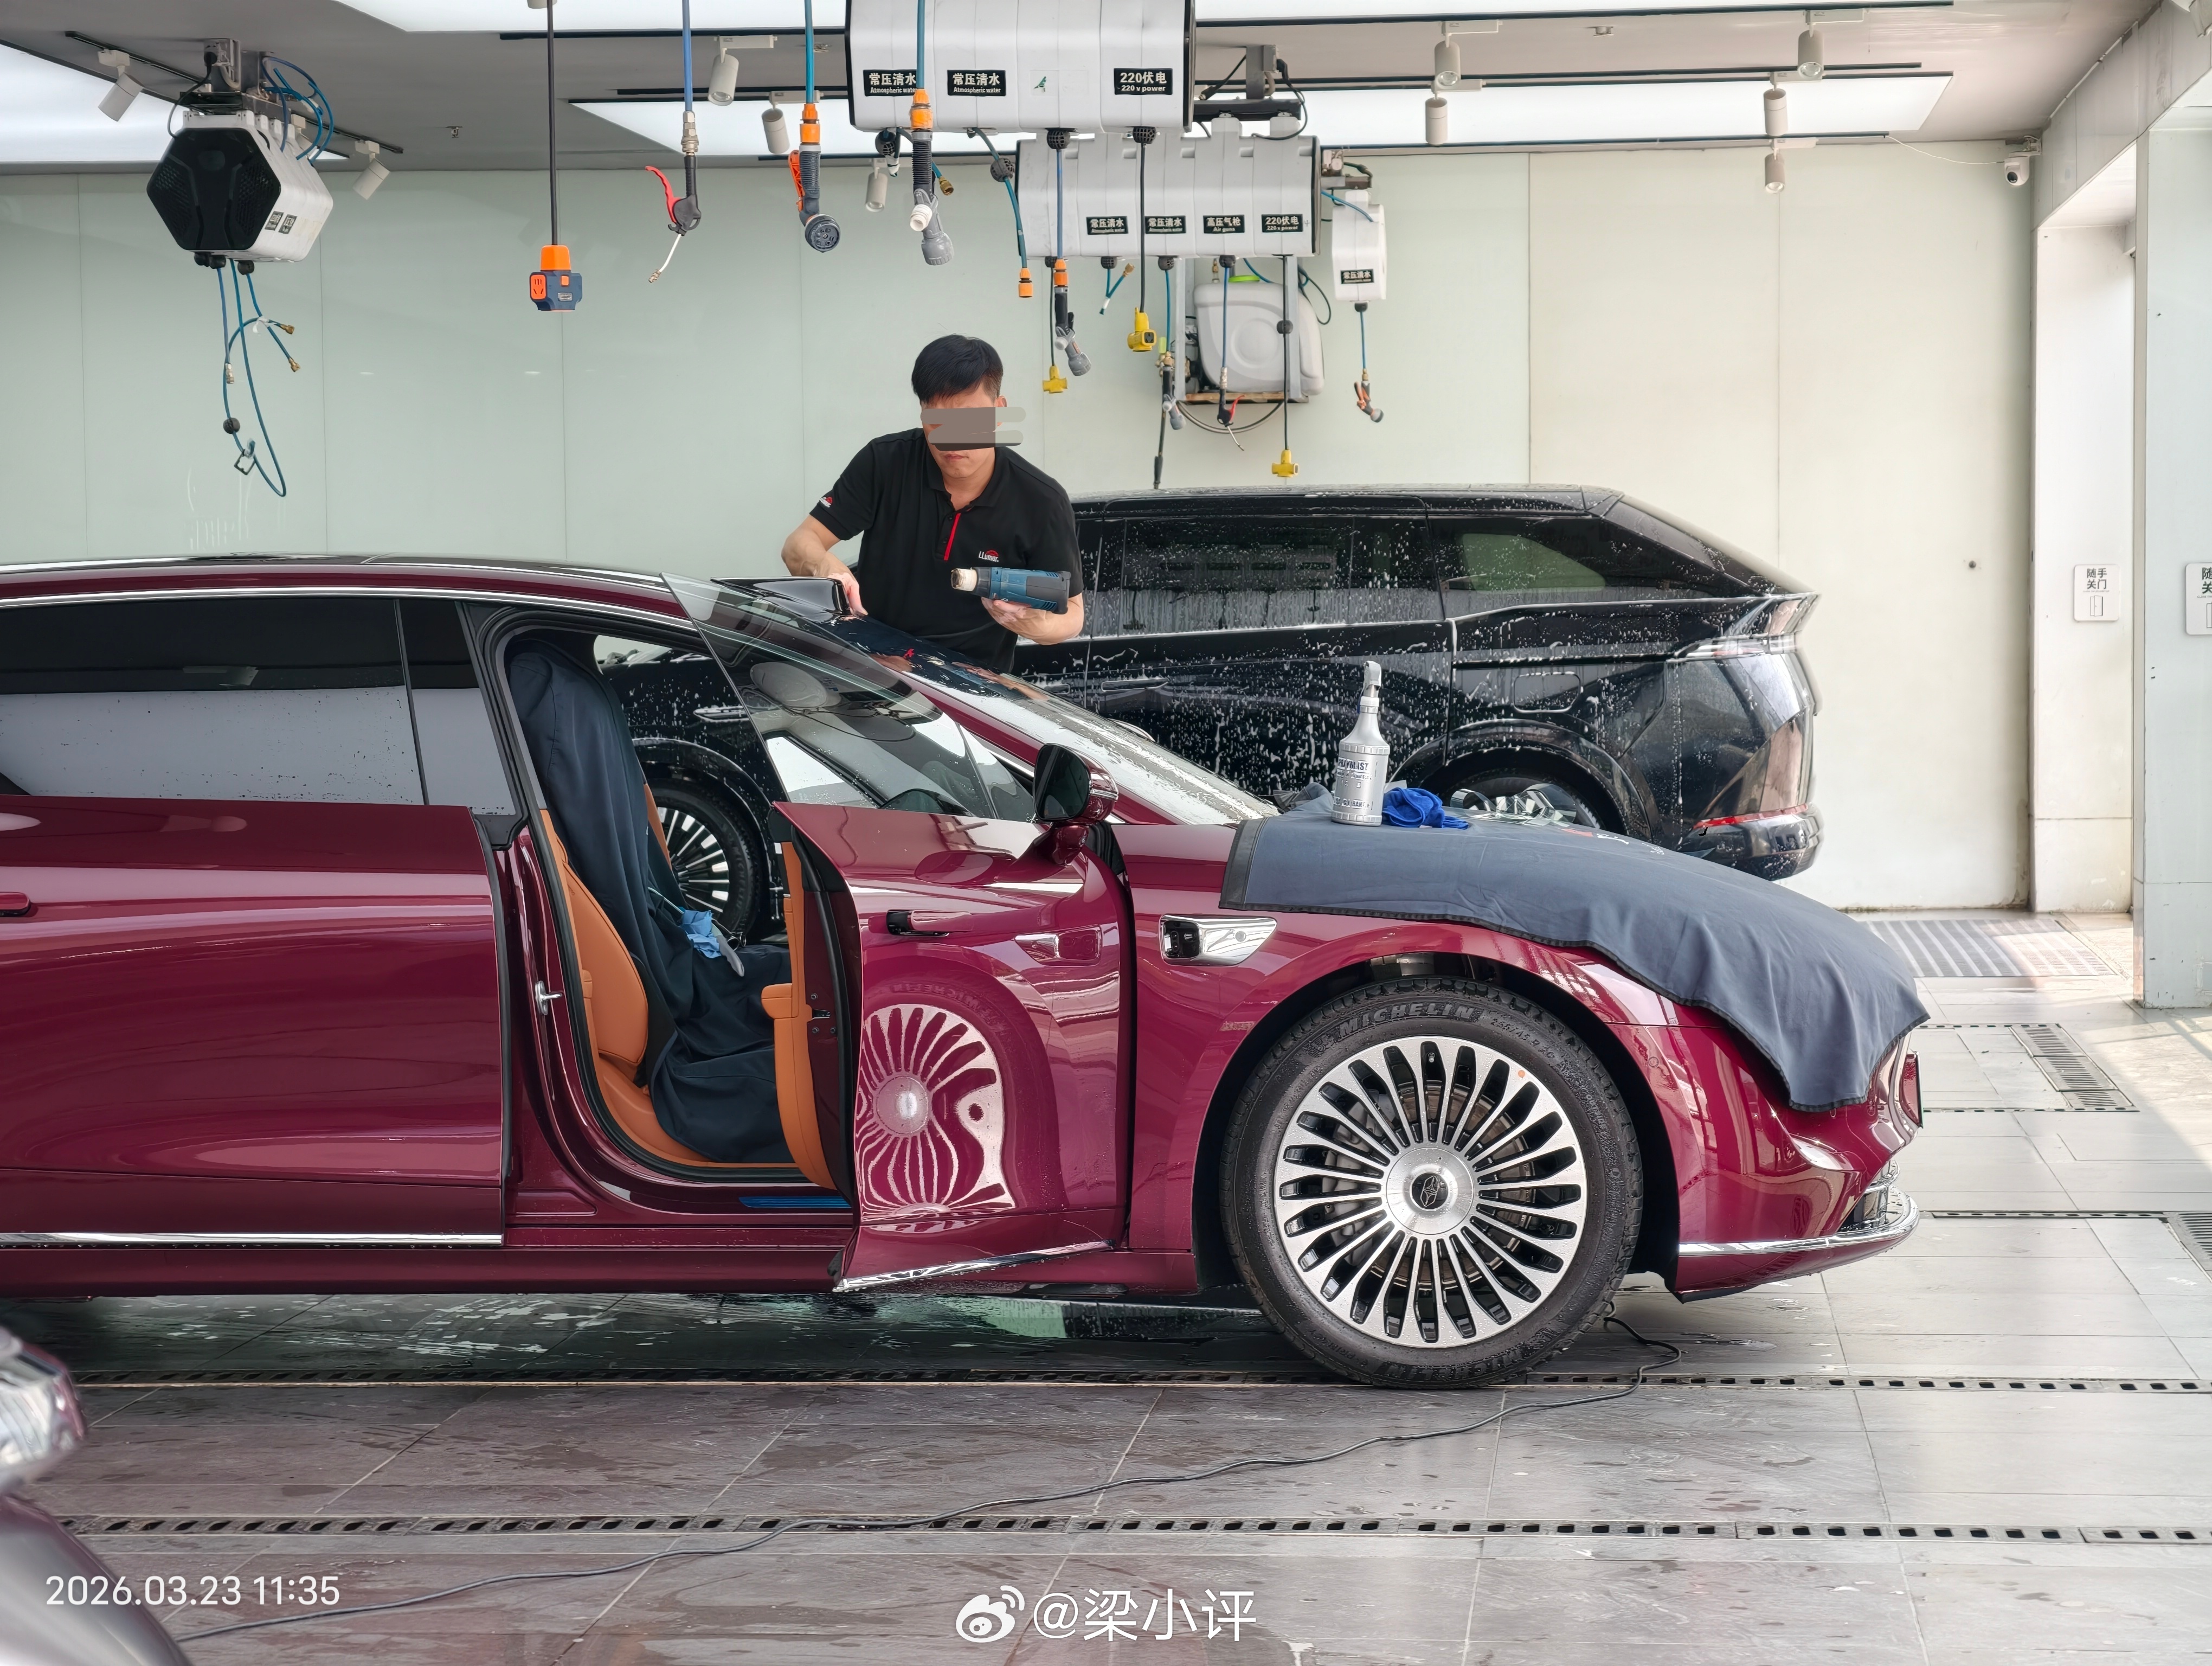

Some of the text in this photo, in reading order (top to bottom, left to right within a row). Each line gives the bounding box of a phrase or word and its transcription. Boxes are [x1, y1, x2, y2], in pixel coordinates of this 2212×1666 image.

[869, 72, 917, 86] 常压清水
[953, 72, 1000, 86] 常压清水
[1120, 71, 1167, 84] 220伏电
[1090, 217, 1124, 228] 常压清水
[1148, 217, 1183, 227] 常压清水
[1265, 215, 1300, 226] 220伏电
[2087, 568, 2107, 578] 随手
[2087, 579, 2107, 589] 关门
[1339, 1002, 1475, 1037] MICHELIN
